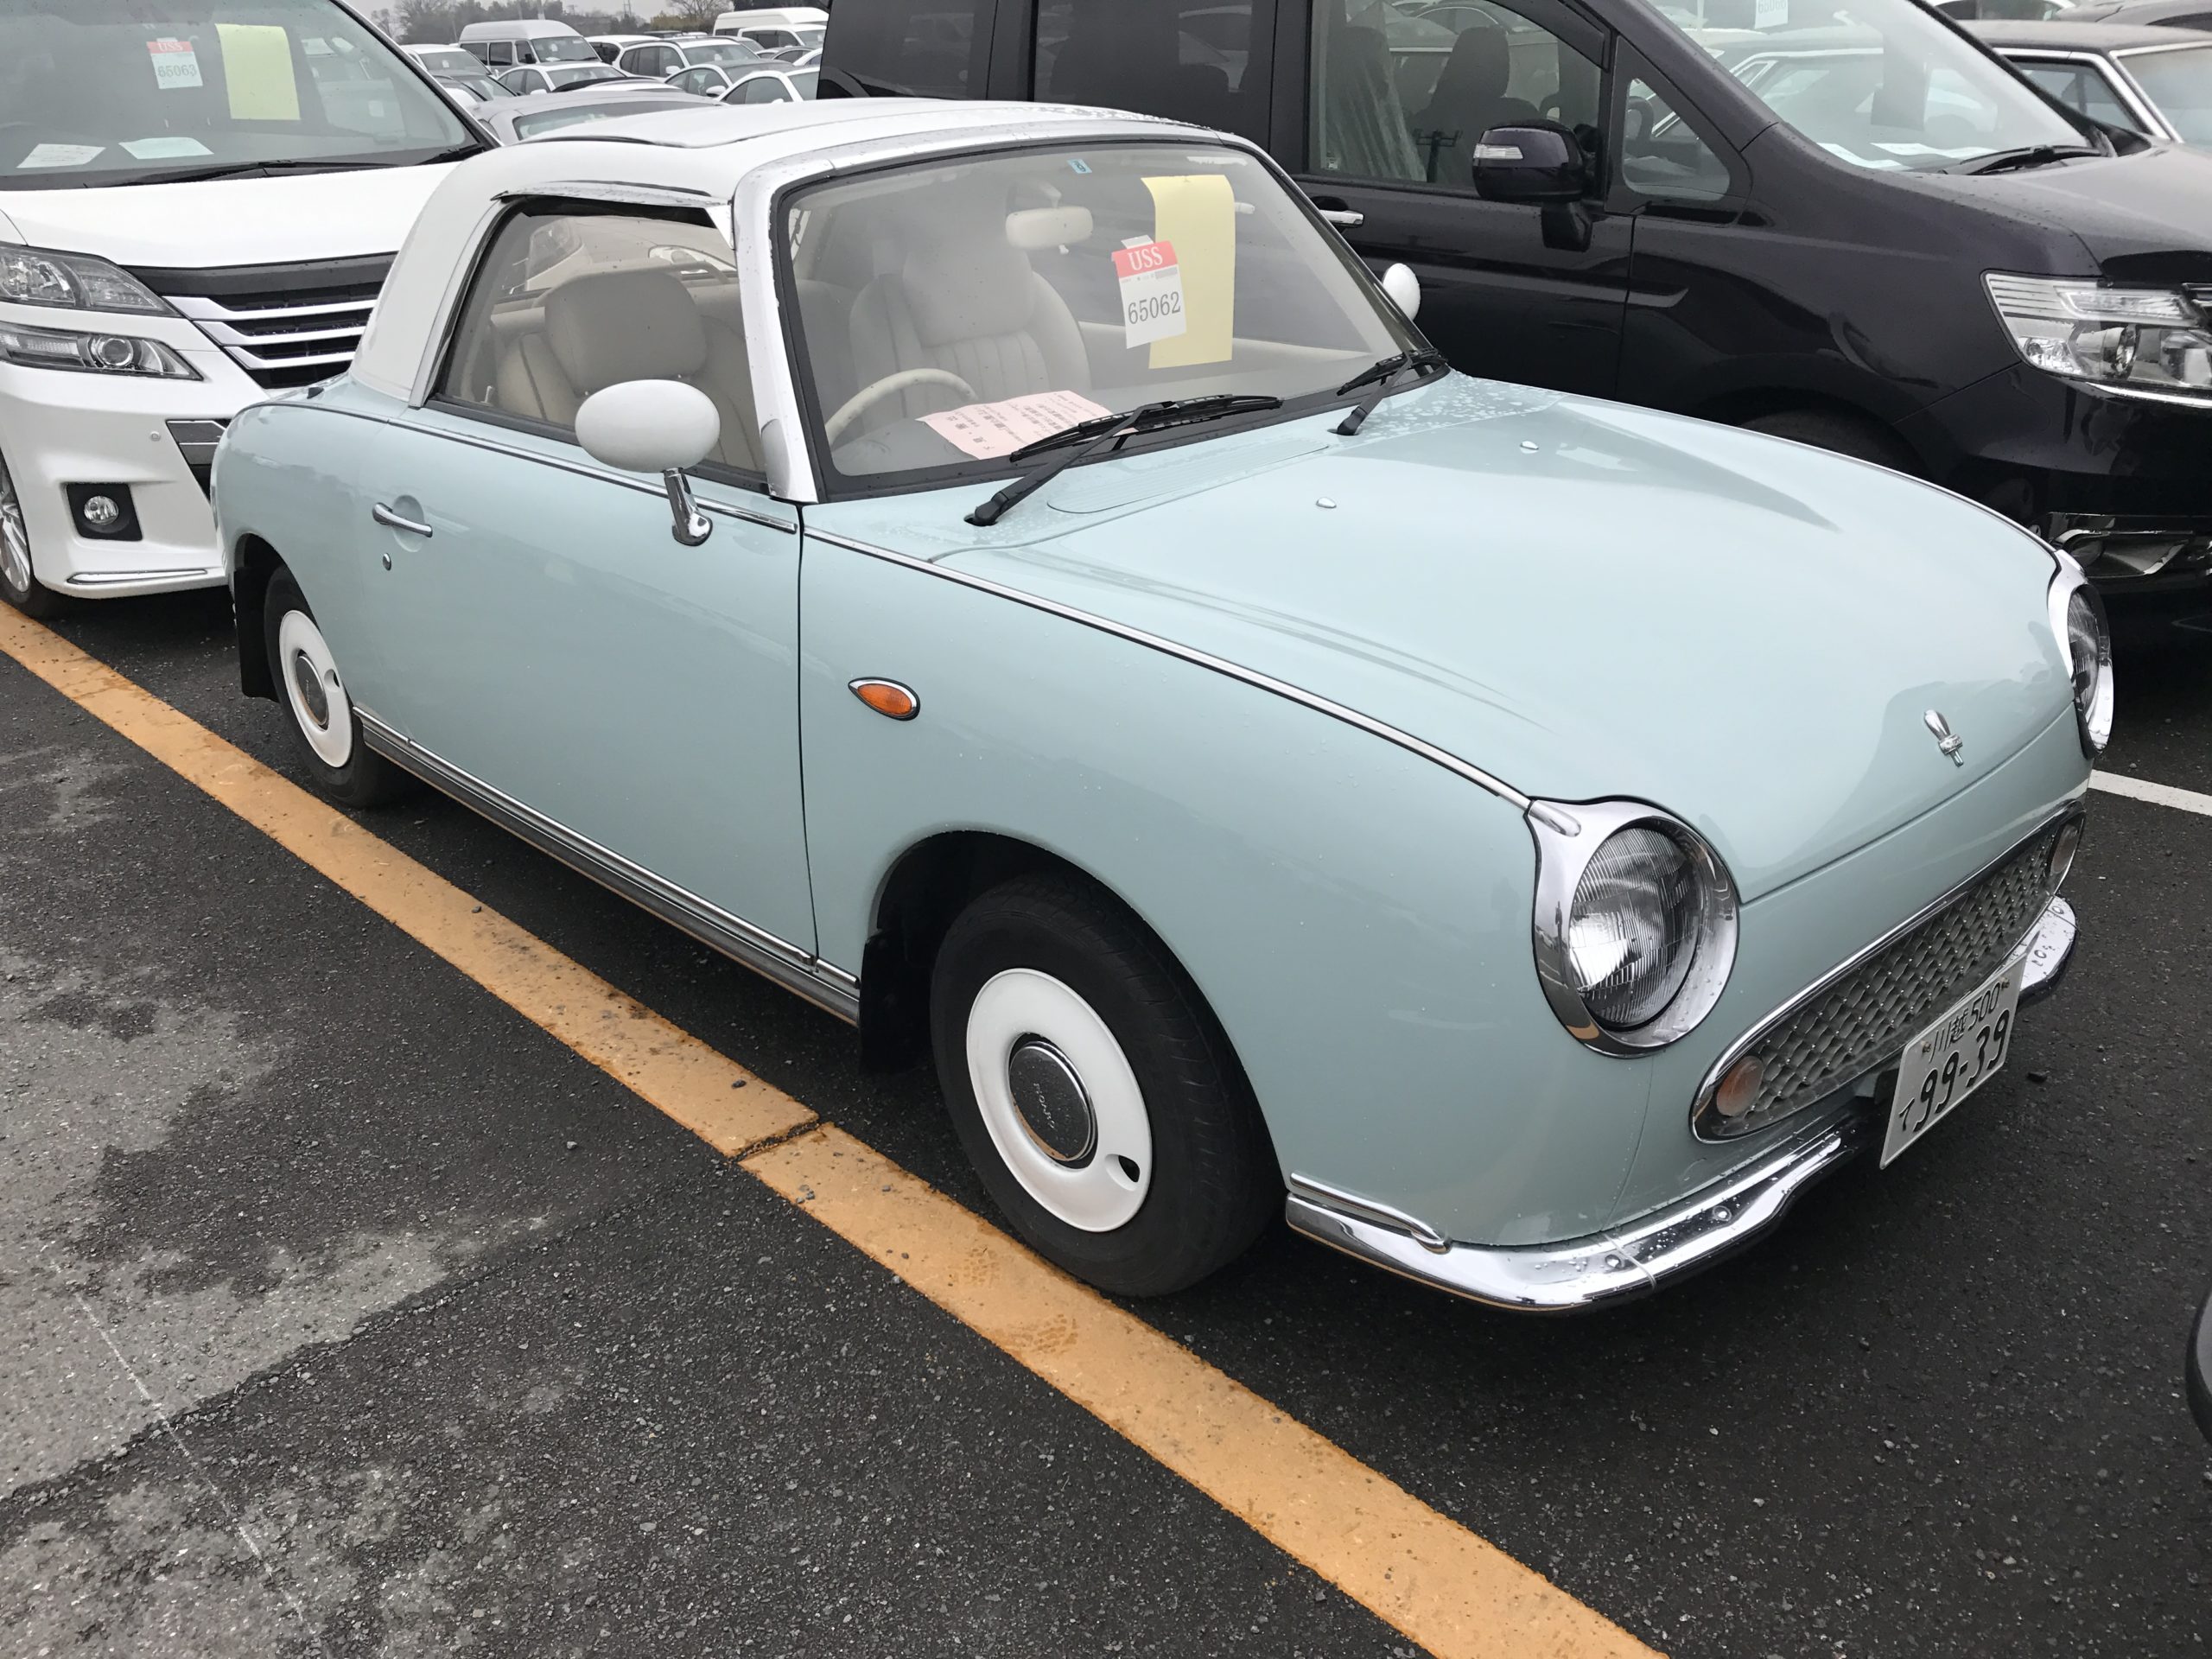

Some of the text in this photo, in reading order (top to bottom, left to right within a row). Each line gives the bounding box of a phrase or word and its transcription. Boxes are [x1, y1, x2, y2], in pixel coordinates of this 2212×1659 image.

[158, 41, 183, 52] USS
[157, 65, 197, 77] 65063
[1128, 246, 1163, 270] USS
[1128, 291, 1181, 325] 65062
[1912, 1008, 2010, 1133] 99-39
